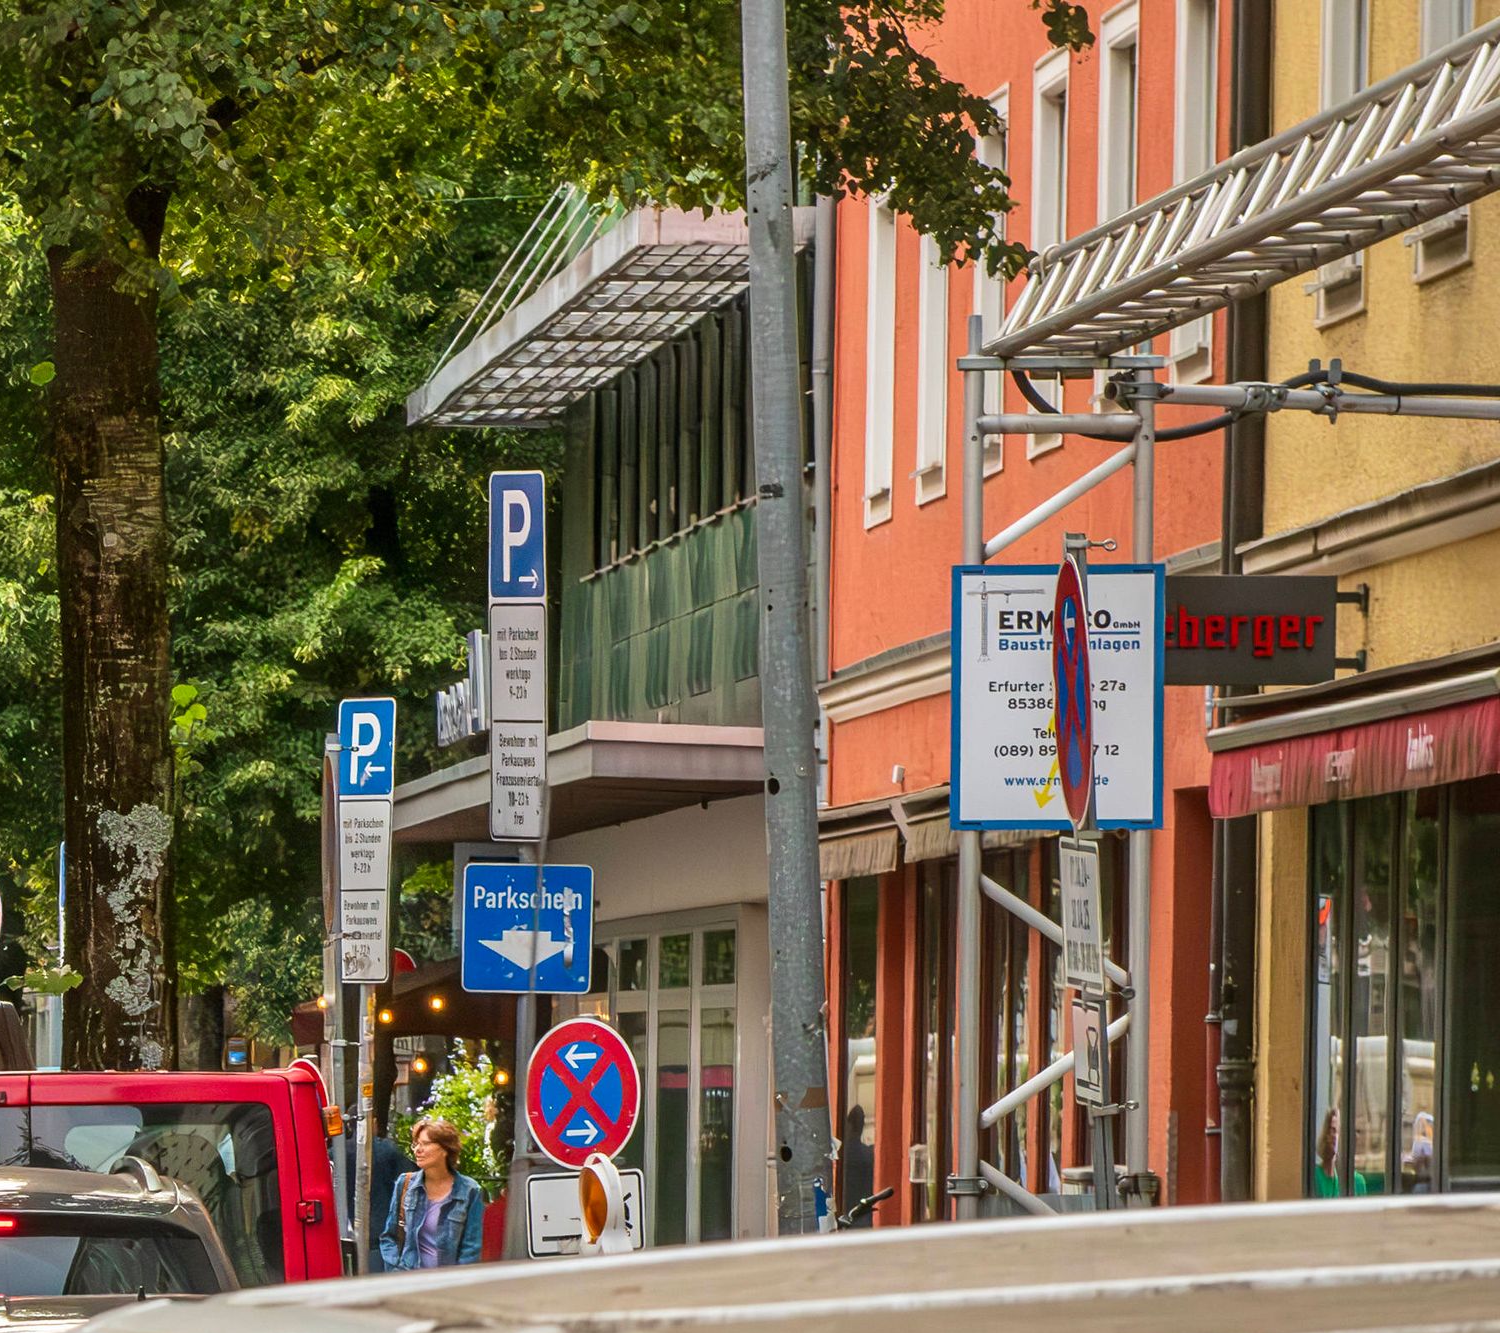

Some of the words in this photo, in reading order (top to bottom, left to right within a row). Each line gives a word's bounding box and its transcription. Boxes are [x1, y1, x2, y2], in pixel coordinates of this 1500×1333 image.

[503, 489, 531, 582] P
[999, 609, 1111, 633] ERMO
[1113, 621, 1140, 632] GmbH
[999, 638, 1140, 653] Baustrnlagen
[506, 667, 530, 683] werktags
[989, 680, 1045, 692] Erfurter
[1100, 680, 1126, 692] 27a
[350, 712, 381, 784] P
[994, 745, 1034, 758] (089)
[1104, 745, 1119, 756] 12
[474, 886, 582, 910] Parkschen
